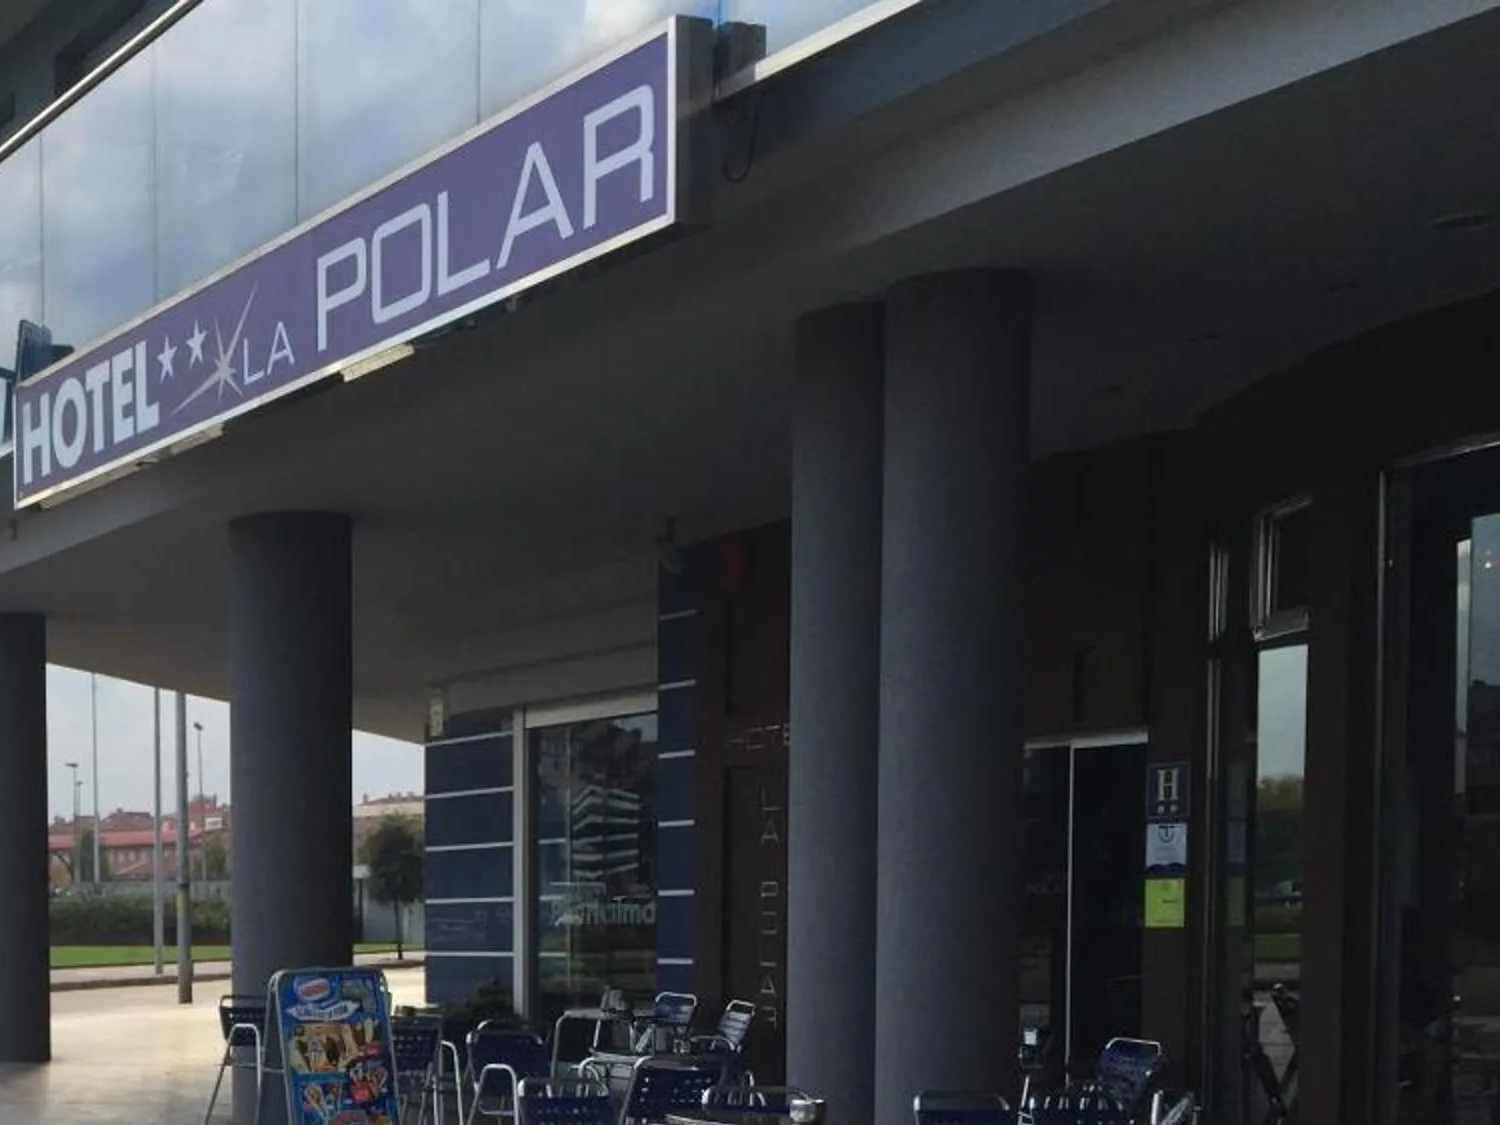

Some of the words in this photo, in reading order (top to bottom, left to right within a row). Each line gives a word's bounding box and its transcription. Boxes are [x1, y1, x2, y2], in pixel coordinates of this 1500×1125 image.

[22, 339, 160, 486] HOTEL
[242, 321, 296, 385] LA
[316, 84, 656, 353] POLAR
